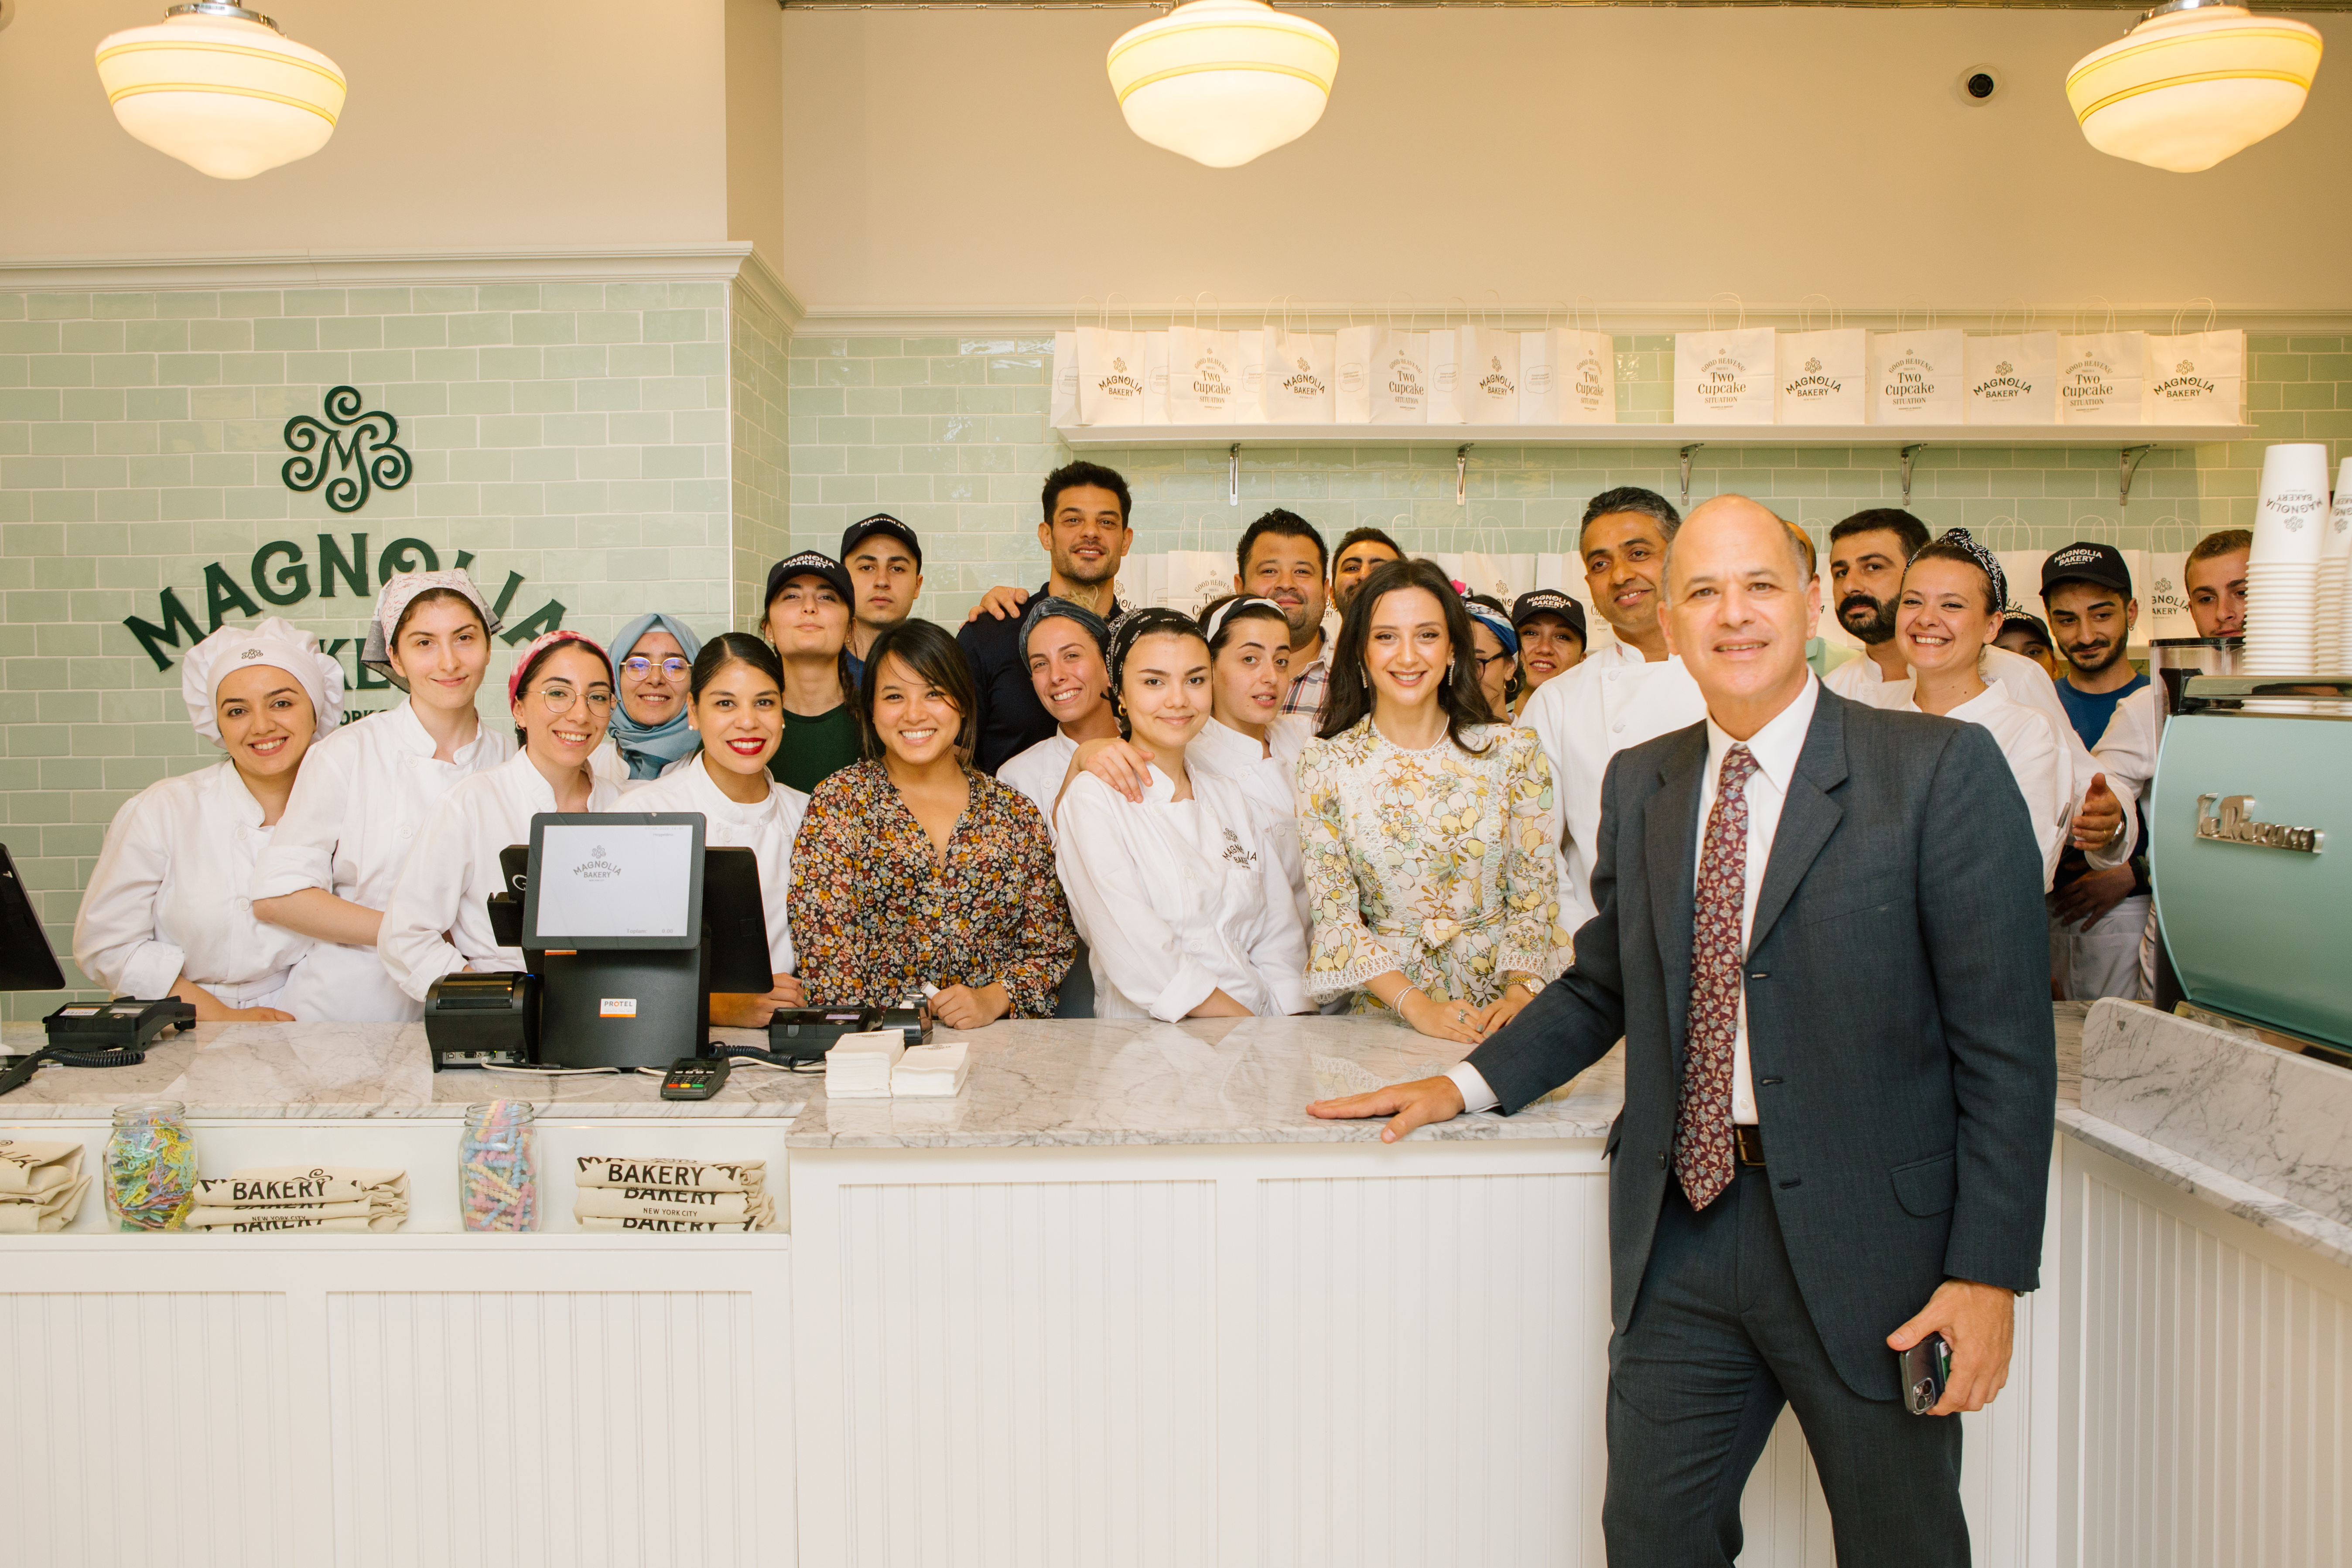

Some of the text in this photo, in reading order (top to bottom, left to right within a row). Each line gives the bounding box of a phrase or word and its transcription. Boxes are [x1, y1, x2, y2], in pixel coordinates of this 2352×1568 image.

[1194, 358, 1206, 369] GOOD
[1701, 358, 1746, 372] GOOD HEAVENS!
[1889, 358, 1934, 373] GOOD HEAVENS!
[2065, 362, 2083, 374] GOOD
[1202, 370, 1220, 383] Two
[1397, 370, 1415, 383] Two
[1583, 371, 1598, 384] Two
[1710, 372, 1734, 383] Two
[1897, 372, 1921, 383] Two
[2075, 374, 2100, 385] Two
[1098, 375, 1142, 395] MAGNOLIA
[1193, 381, 1231, 395] Cupcake
[1283, 374, 1325, 394] MAGNOLIA
[1294, 386, 1317, 396] BAKERY
[1389, 381, 1424, 396] Cupcake
[1479, 374, 1514, 394] MAGNOLIA
[1488, 386, 1508, 396] BAKERY
[1576, 382, 1604, 396] Cupcake
[1698, 382, 1746, 396] Cupcake
[1785, 376, 1841, 395] MAGNOLIA
[1886, 382, 1934, 397] Cupcake
[1973, 377, 2032, 396] MAGNOLIA
[2063, 384, 2113, 398] Cupcake
[2153, 376, 2214, 395] MAGNOLIA
[1109, 388, 1133, 396] BAKERY
[1798, 388, 1829, 396] BAKERY
[1986, 389, 2019, 398] BAKERY
[2167, 389, 2201, 398] BAKERY
[1395, 396, 1419, 404] SITUATION
[2266, 498, 2323, 514] MAGNOLIA
[783, 555, 835, 569] MAGNOLIA
[2054, 549, 2102, 563] MAGNOLIA
[2059, 555, 2095, 566] BAKERY
[1194, 580, 1209, 593] GOOD
[1527, 594, 1571, 608] MAGNOLIA
[1532, 600, 1566, 609] BAKERY
[573, 861, 621, 876] MAGNOLIA
[608, 1164, 707, 1186] BAKERY
[233, 1181, 326, 1200] BAKERY
